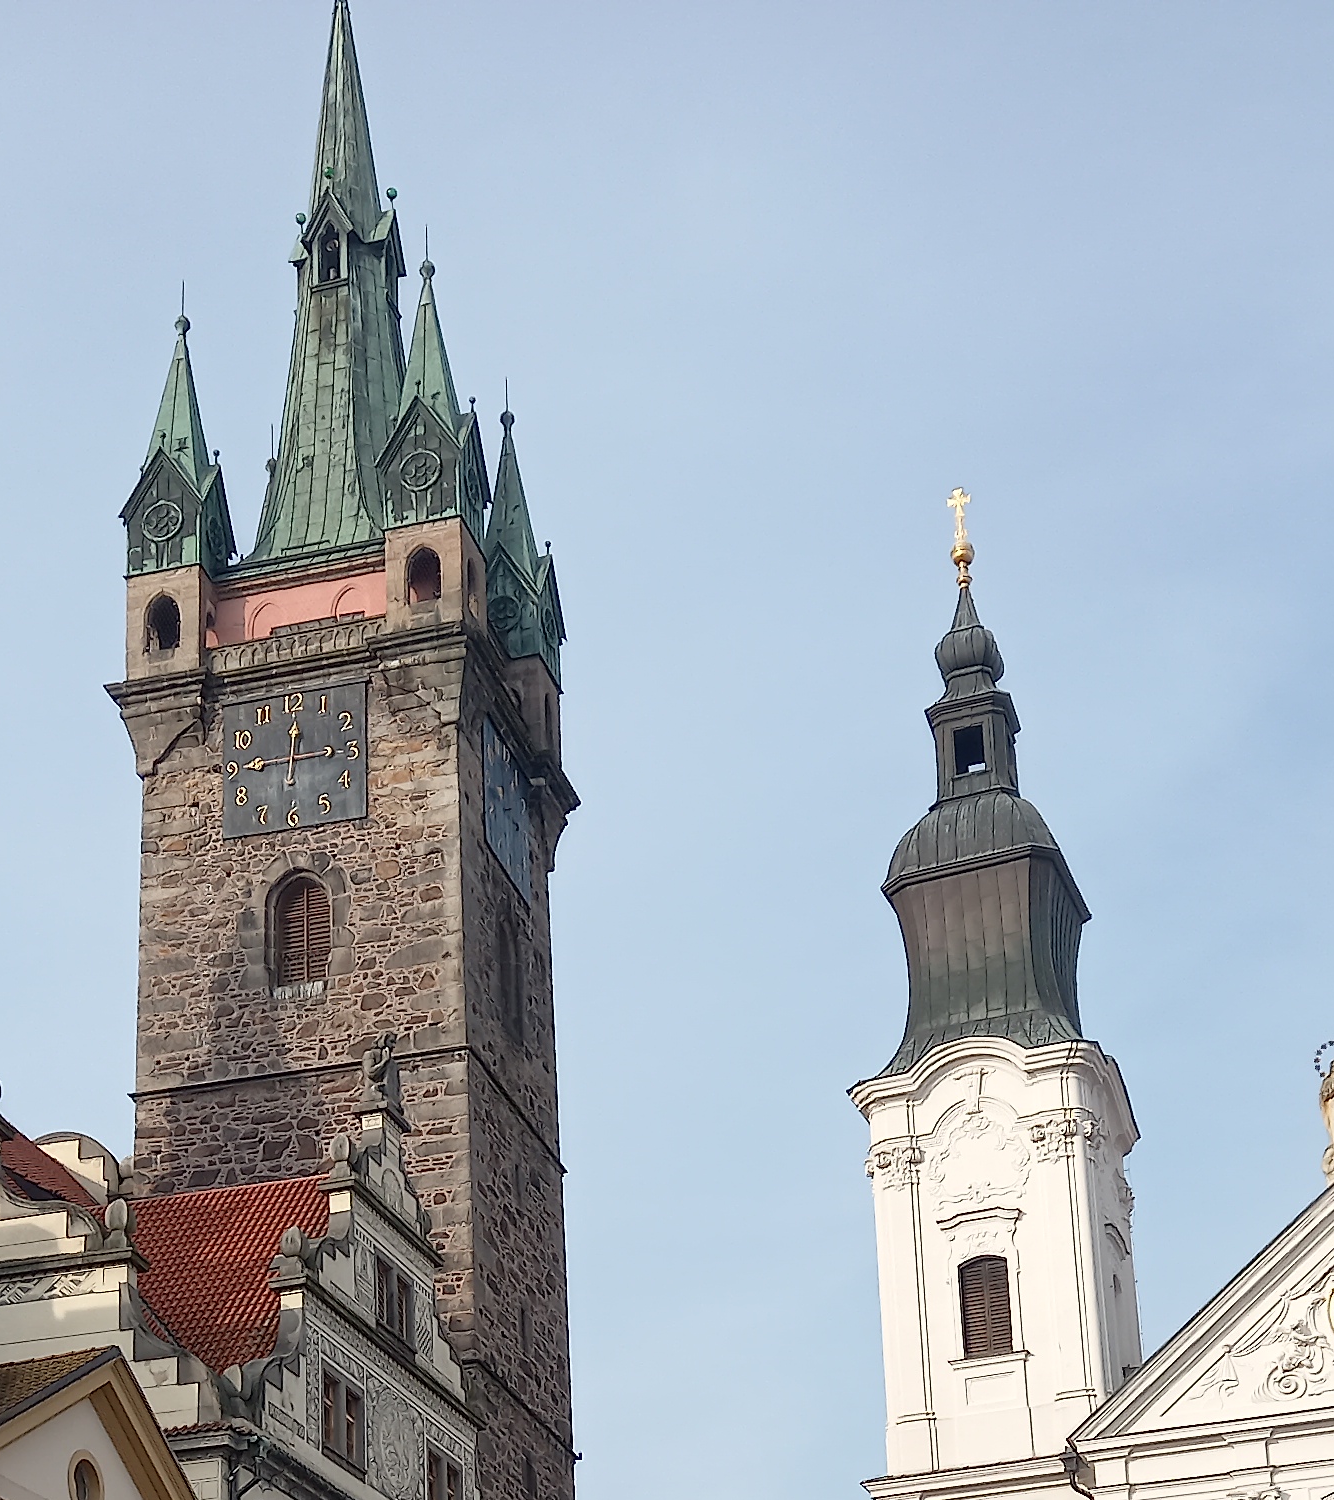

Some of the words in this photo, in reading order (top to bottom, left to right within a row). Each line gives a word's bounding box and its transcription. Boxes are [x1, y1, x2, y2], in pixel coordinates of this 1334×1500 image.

[282, 693, 304, 714] 12
[318, 695, 326, 715] 1
[254, 705, 271, 726] 11
[338, 711, 353, 732] 2
[233, 730, 252, 750] 10
[346, 740, 359, 760] 3
[226, 761, 239, 780] 9
[337, 769, 351, 789] 4
[235, 786, 247, 806] 8
[318, 793, 331, 815] 5
[256, 804, 268, 825] 7
[287, 806, 299, 827] 6
